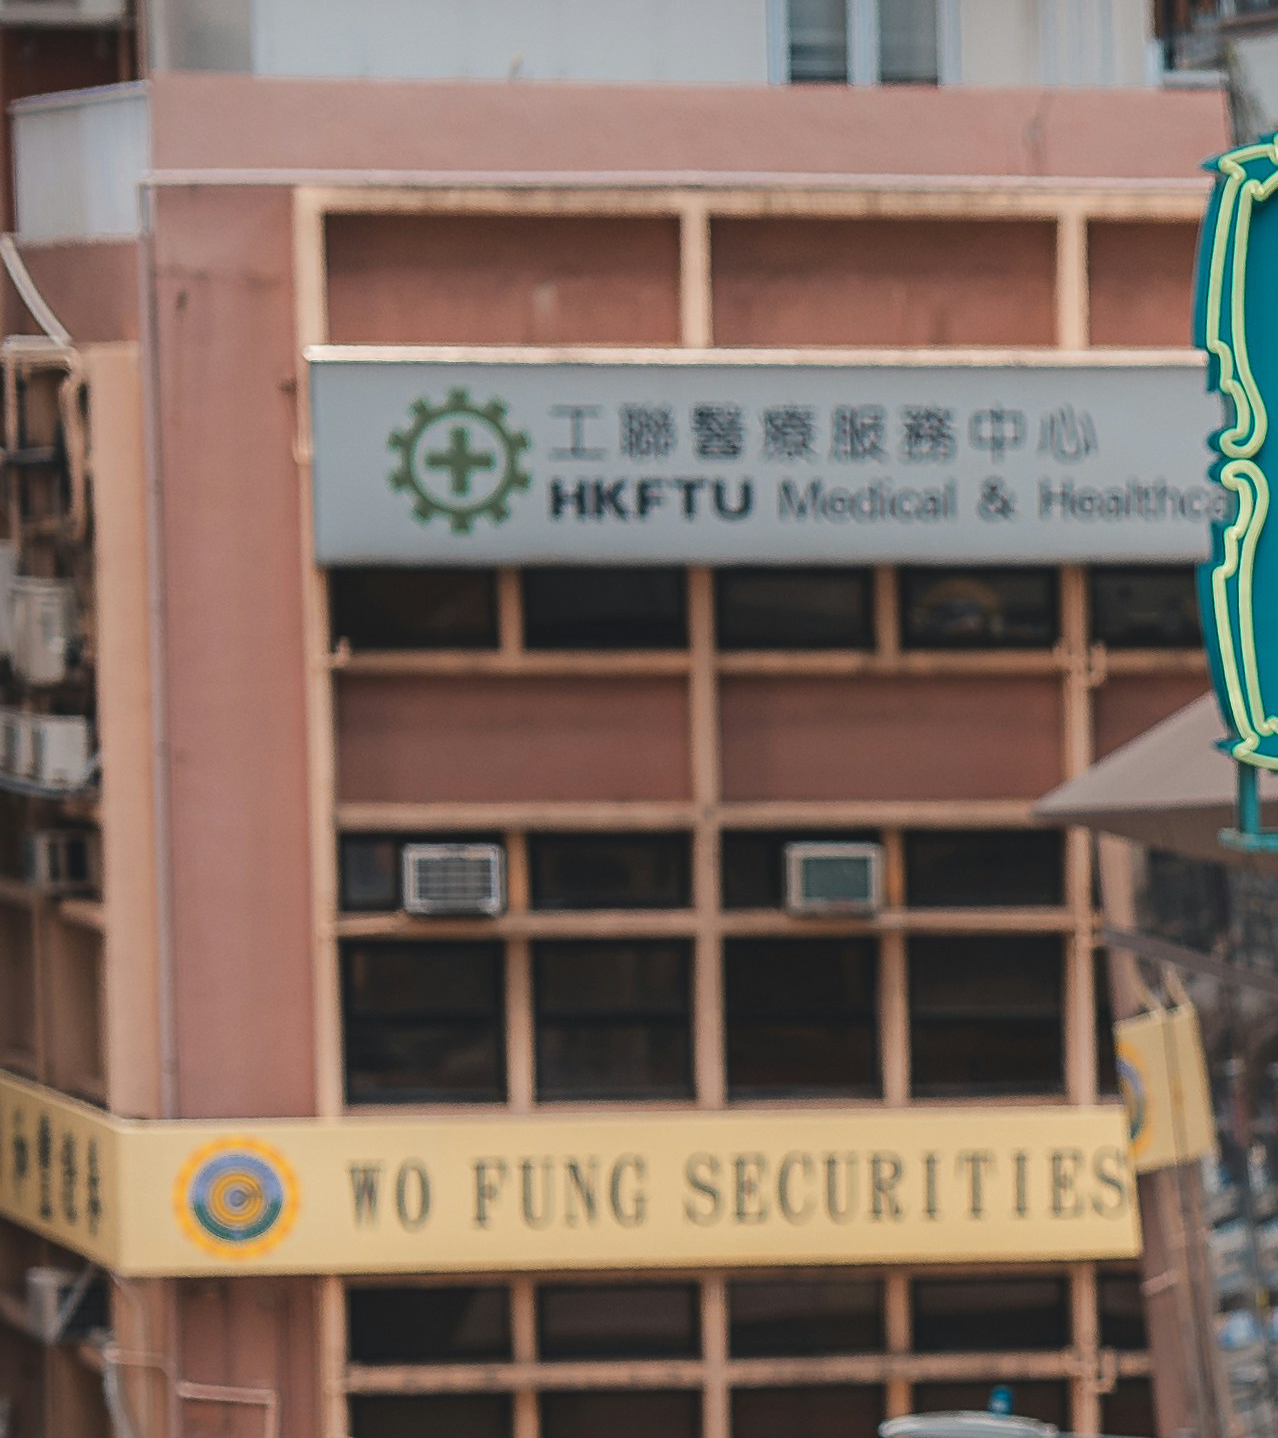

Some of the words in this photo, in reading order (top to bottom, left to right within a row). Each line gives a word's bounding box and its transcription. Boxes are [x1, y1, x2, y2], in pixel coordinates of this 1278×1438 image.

[548, 402, 1098, 463] 工聯醫療服務中心
[548, 475, 752, 523] HKFTU
[776, 475, 957, 523] Medical
[977, 476, 1014, 522] &
[349, 1158, 431, 1232] WO
[473, 1153, 650, 1229] FUNG
[684, 1145, 1129, 1227] SECURITIES
